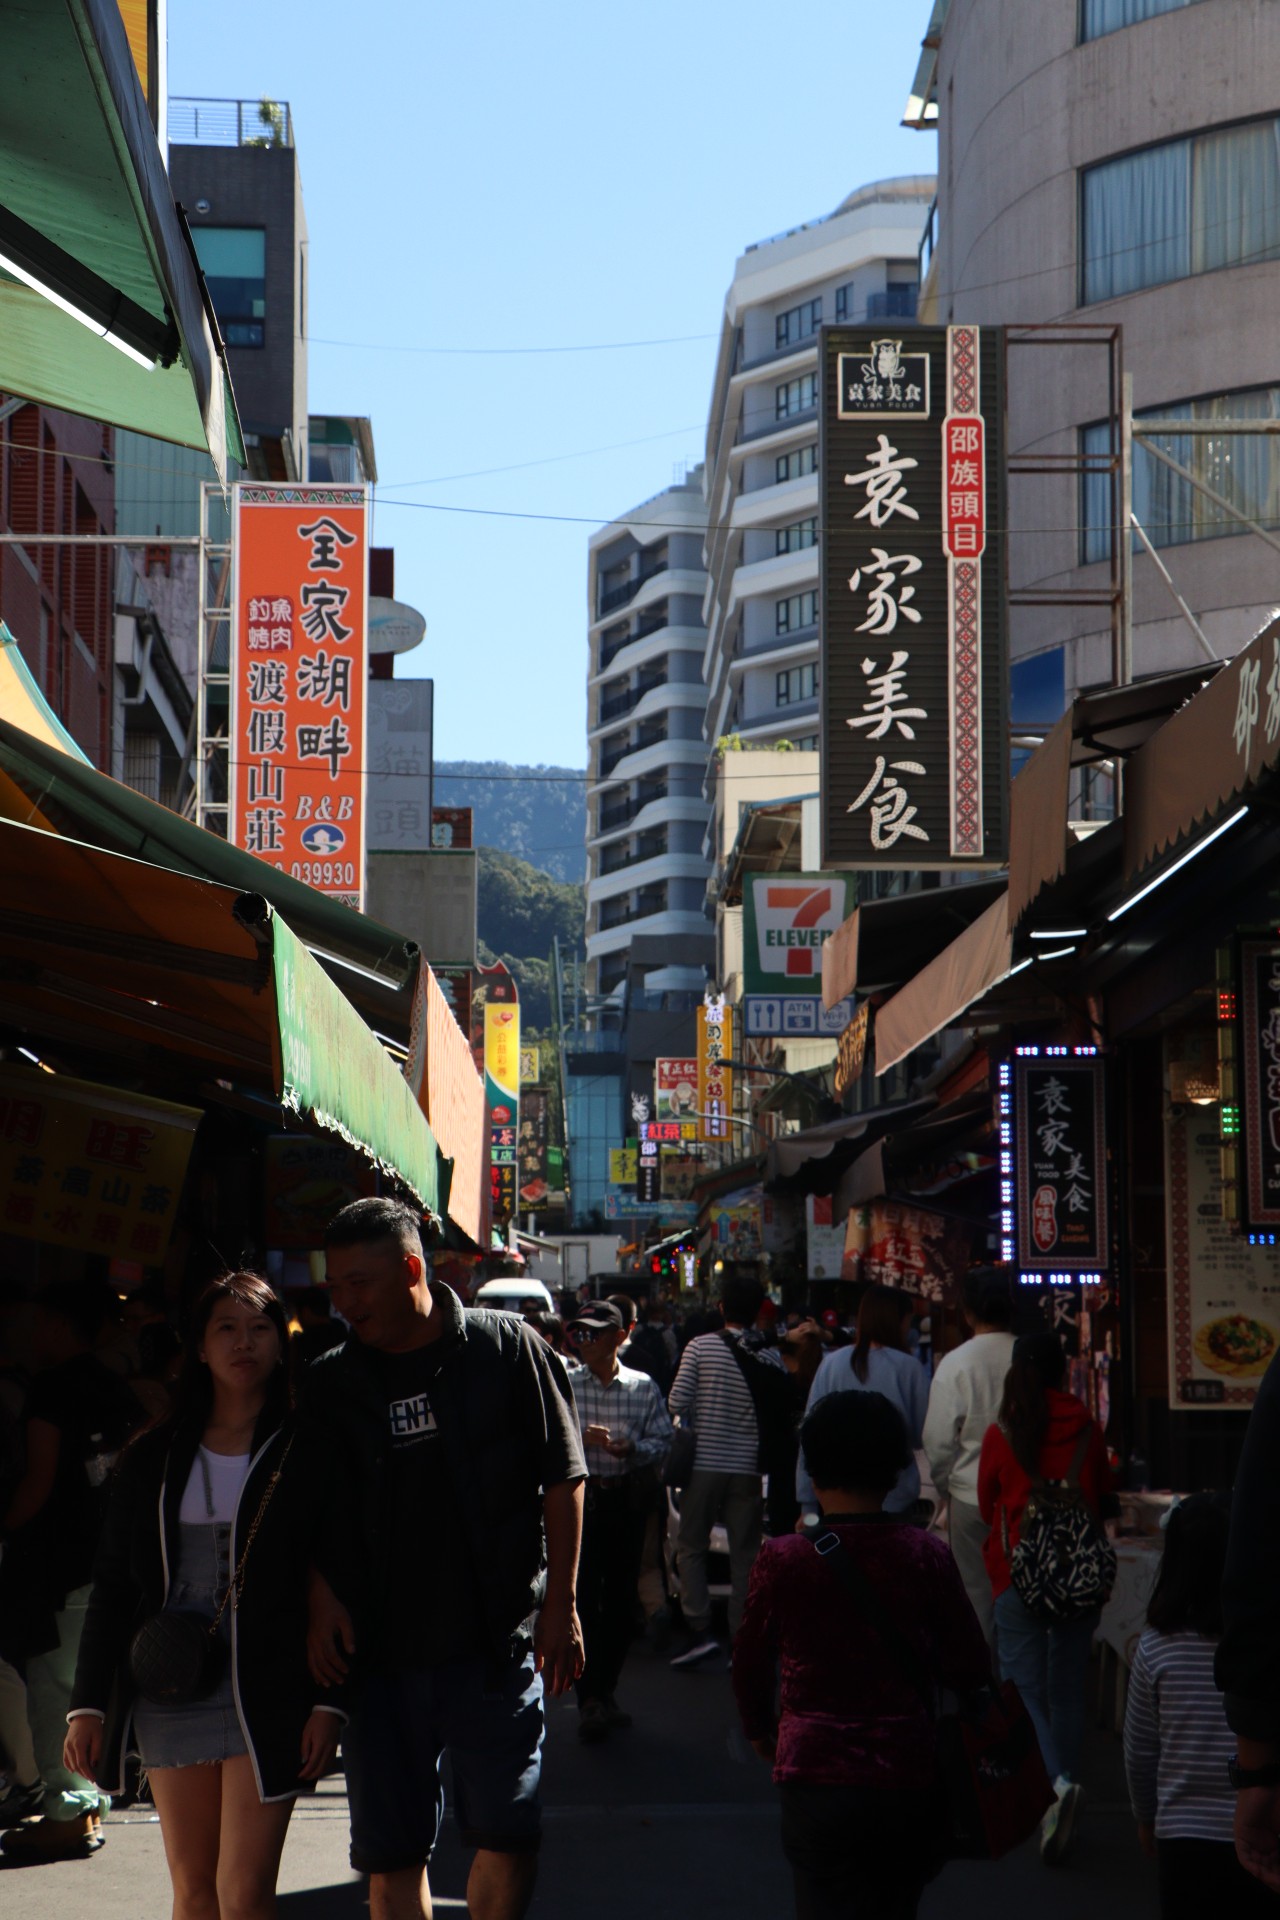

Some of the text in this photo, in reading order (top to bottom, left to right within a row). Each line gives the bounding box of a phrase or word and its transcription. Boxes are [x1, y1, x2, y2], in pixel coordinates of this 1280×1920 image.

[848, 381, 922, 402] 袁家美食
[949, 426, 980, 553] 邵族頭目
[297, 515, 356, 781] 全家湖畔
[843, 433, 931, 851] 袁家美食
[246, 661, 286, 854] 渡假山莊
[294, 795, 354, 822] B&B
[788, 1003, 812, 1012] ATM
